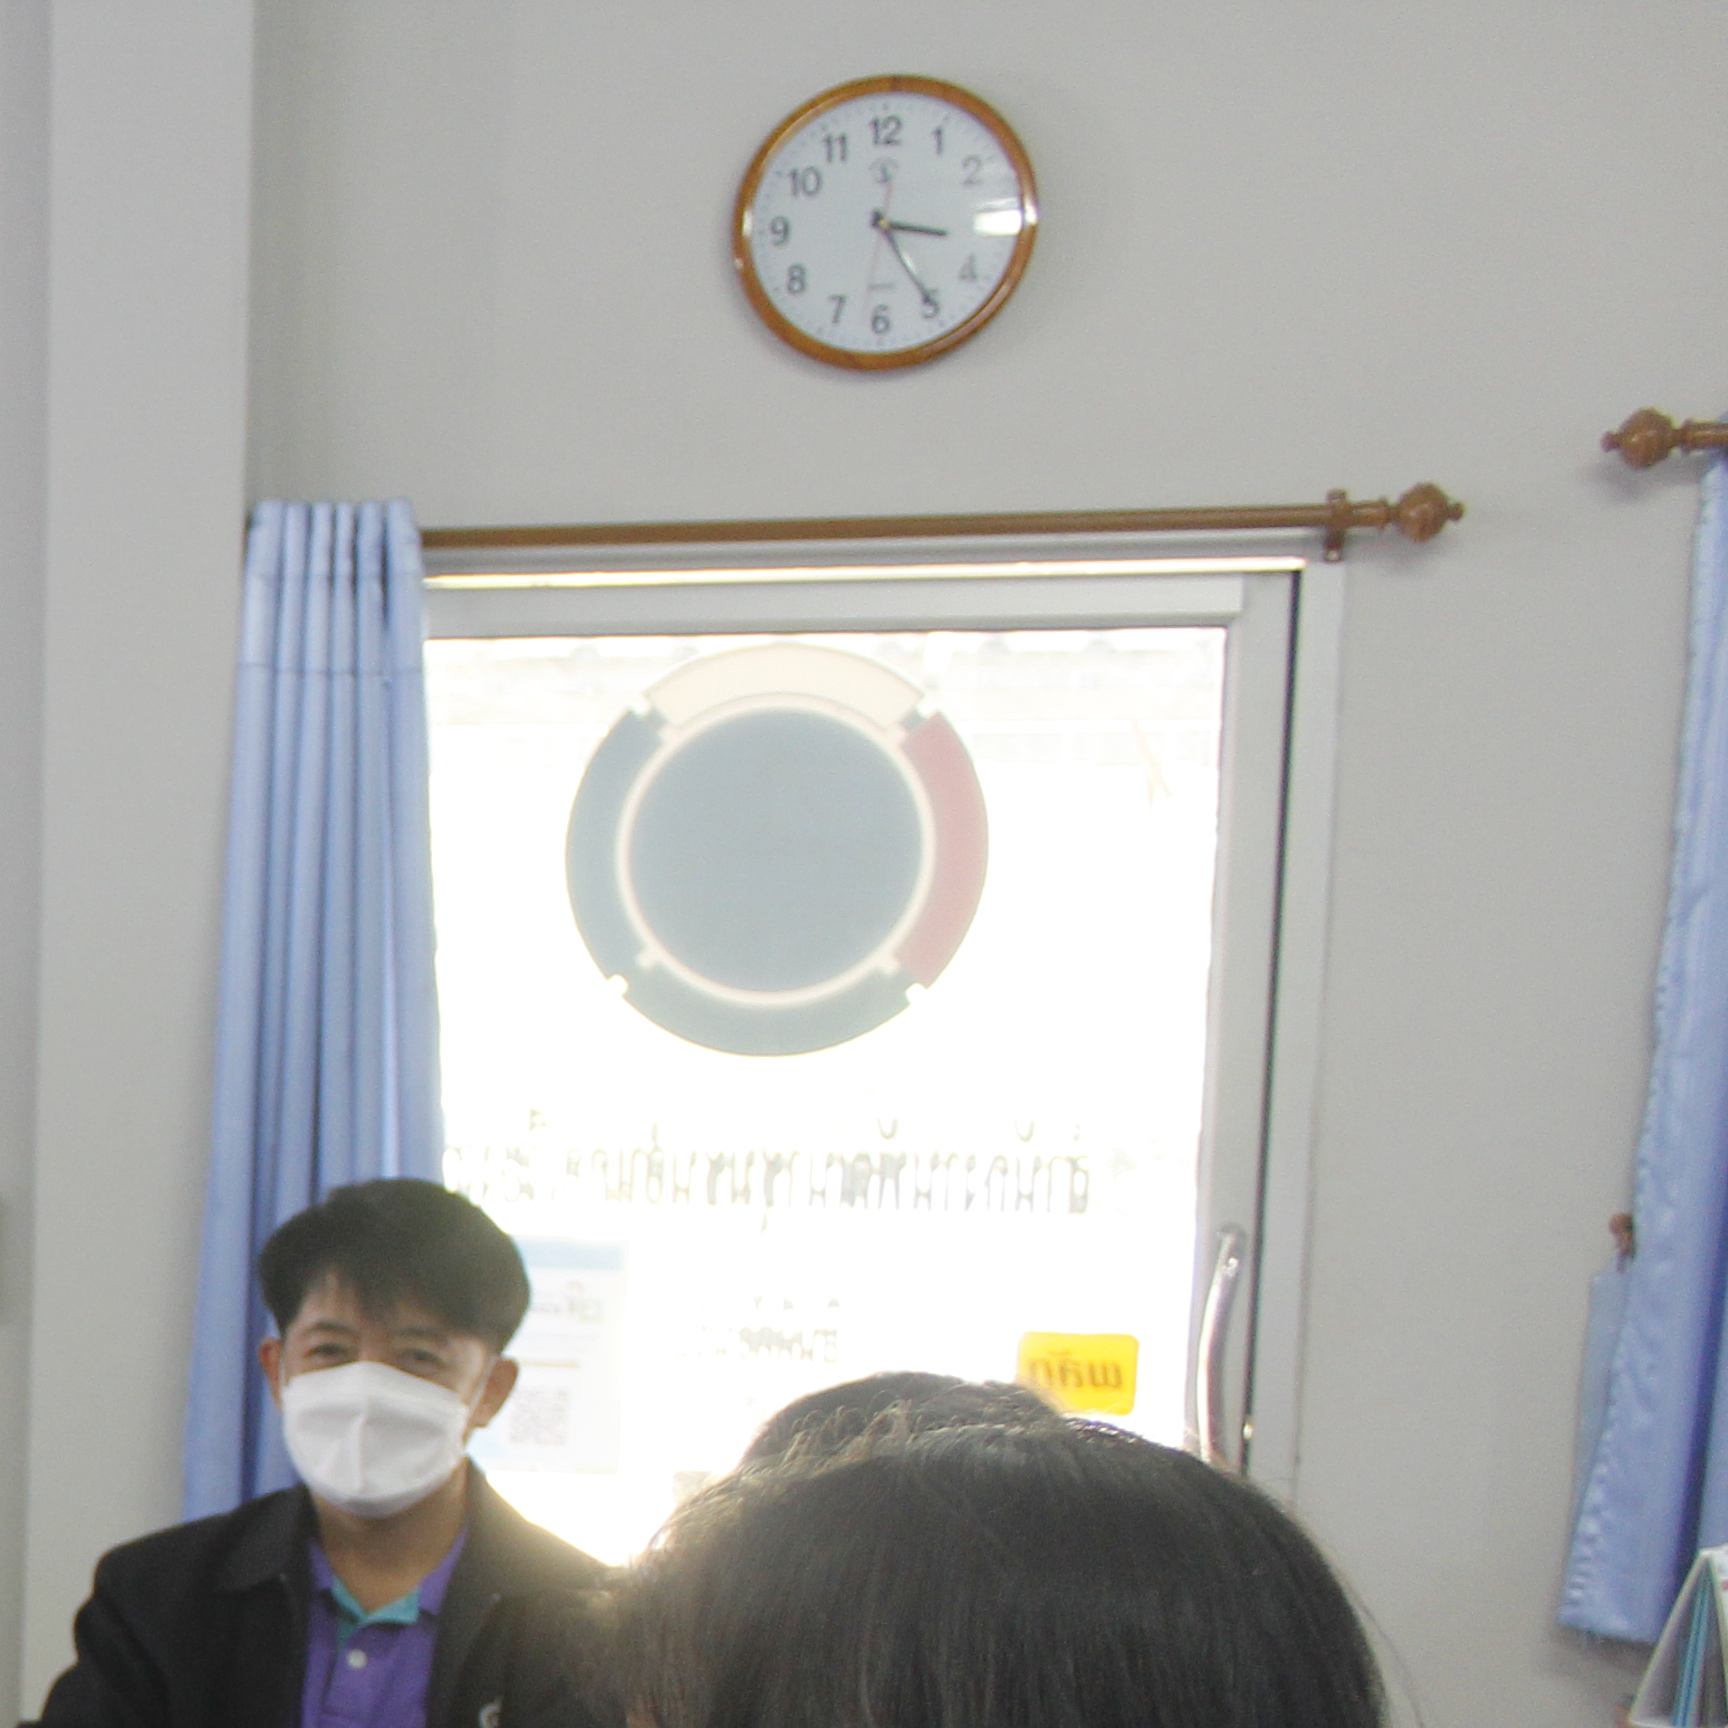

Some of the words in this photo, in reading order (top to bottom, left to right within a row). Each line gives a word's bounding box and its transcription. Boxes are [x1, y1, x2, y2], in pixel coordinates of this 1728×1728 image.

[869, 116, 902, 146] 12
[931, 126, 944, 155] 1
[824, 134, 849, 164] 11
[787, 167, 822, 197] 10
[962, 156, 981, 185] 2
[770, 216, 791, 246] 9
[787, 265, 807, 294] 8
[959, 254, 978, 283] 4
[828, 295, 846, 324] 7
[871, 304, 891, 334] 6
[922, 290, 940, 320] 5
